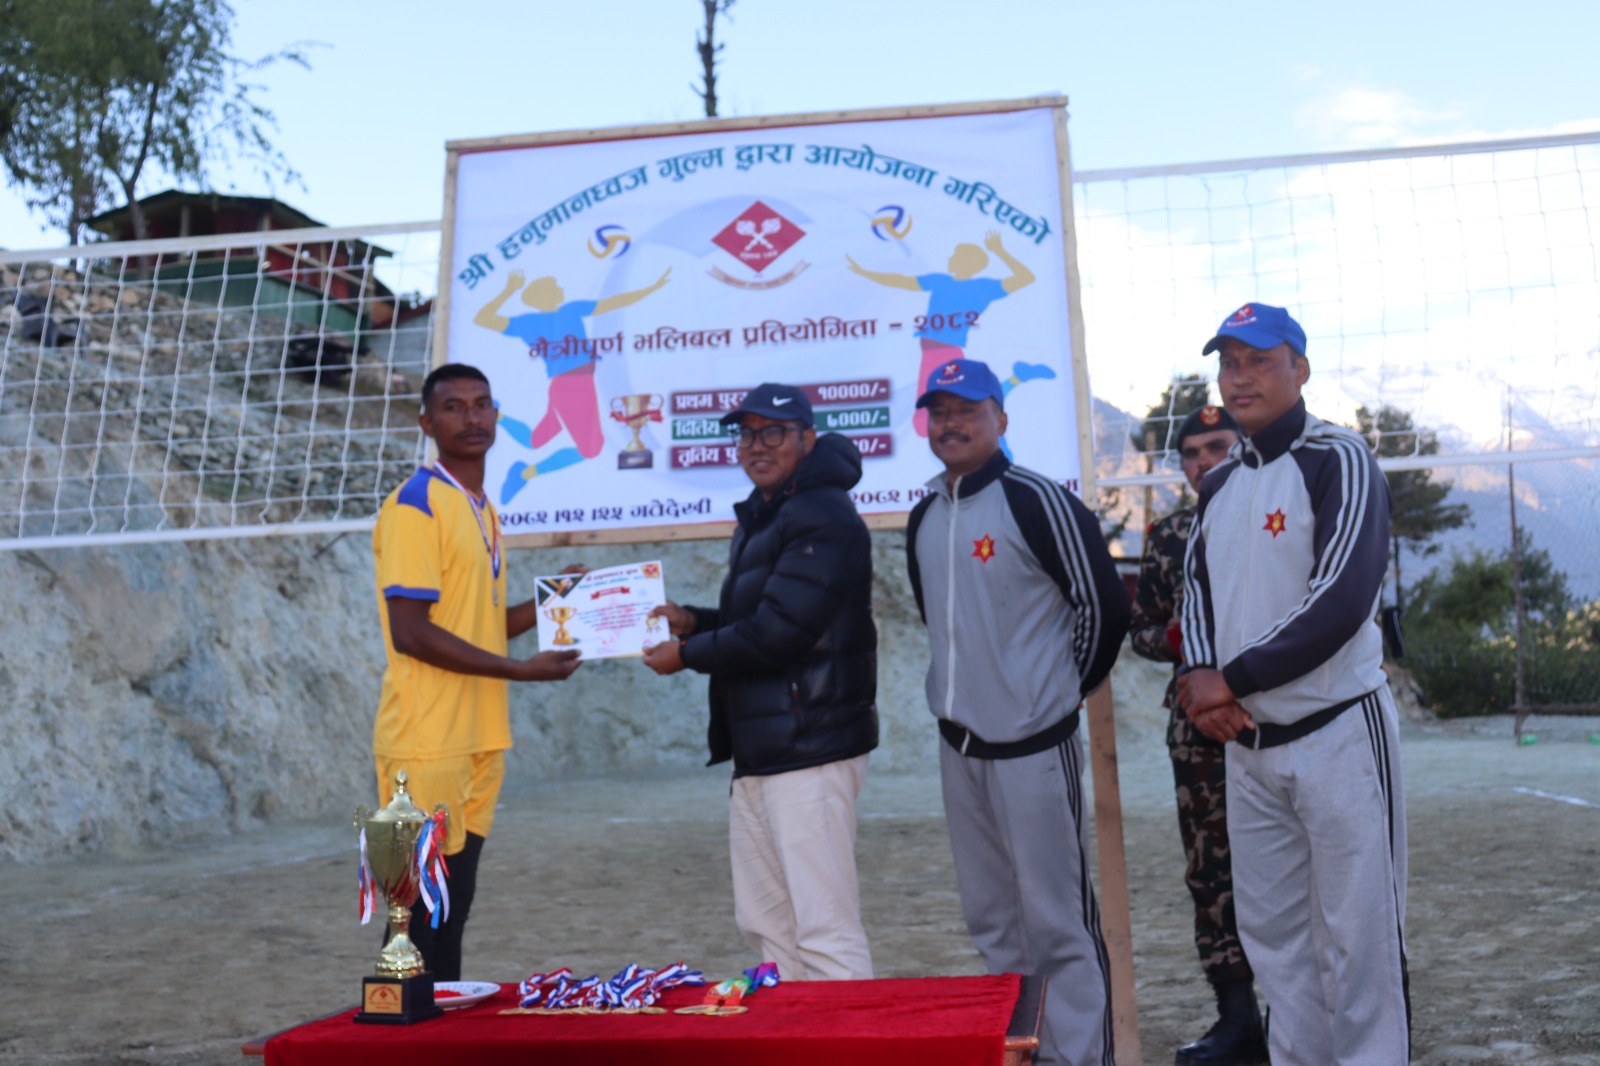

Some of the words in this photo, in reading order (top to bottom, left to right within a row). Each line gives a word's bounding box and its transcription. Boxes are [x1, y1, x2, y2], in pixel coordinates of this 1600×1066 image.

[458, 252, 495, 290] श्री
[656, 147, 725, 183] गुल्म
[735, 143, 795, 171] द्वारा
[804, 143, 938, 189] आयोजना
[942, 175, 1052, 246] गरिएको
[633, 325, 732, 352] भलिबल
[742, 315, 877, 346] प्रतियोगिता
[914, 310, 981, 333] २०८२
[817, 381, 887, 401] १००००/-
